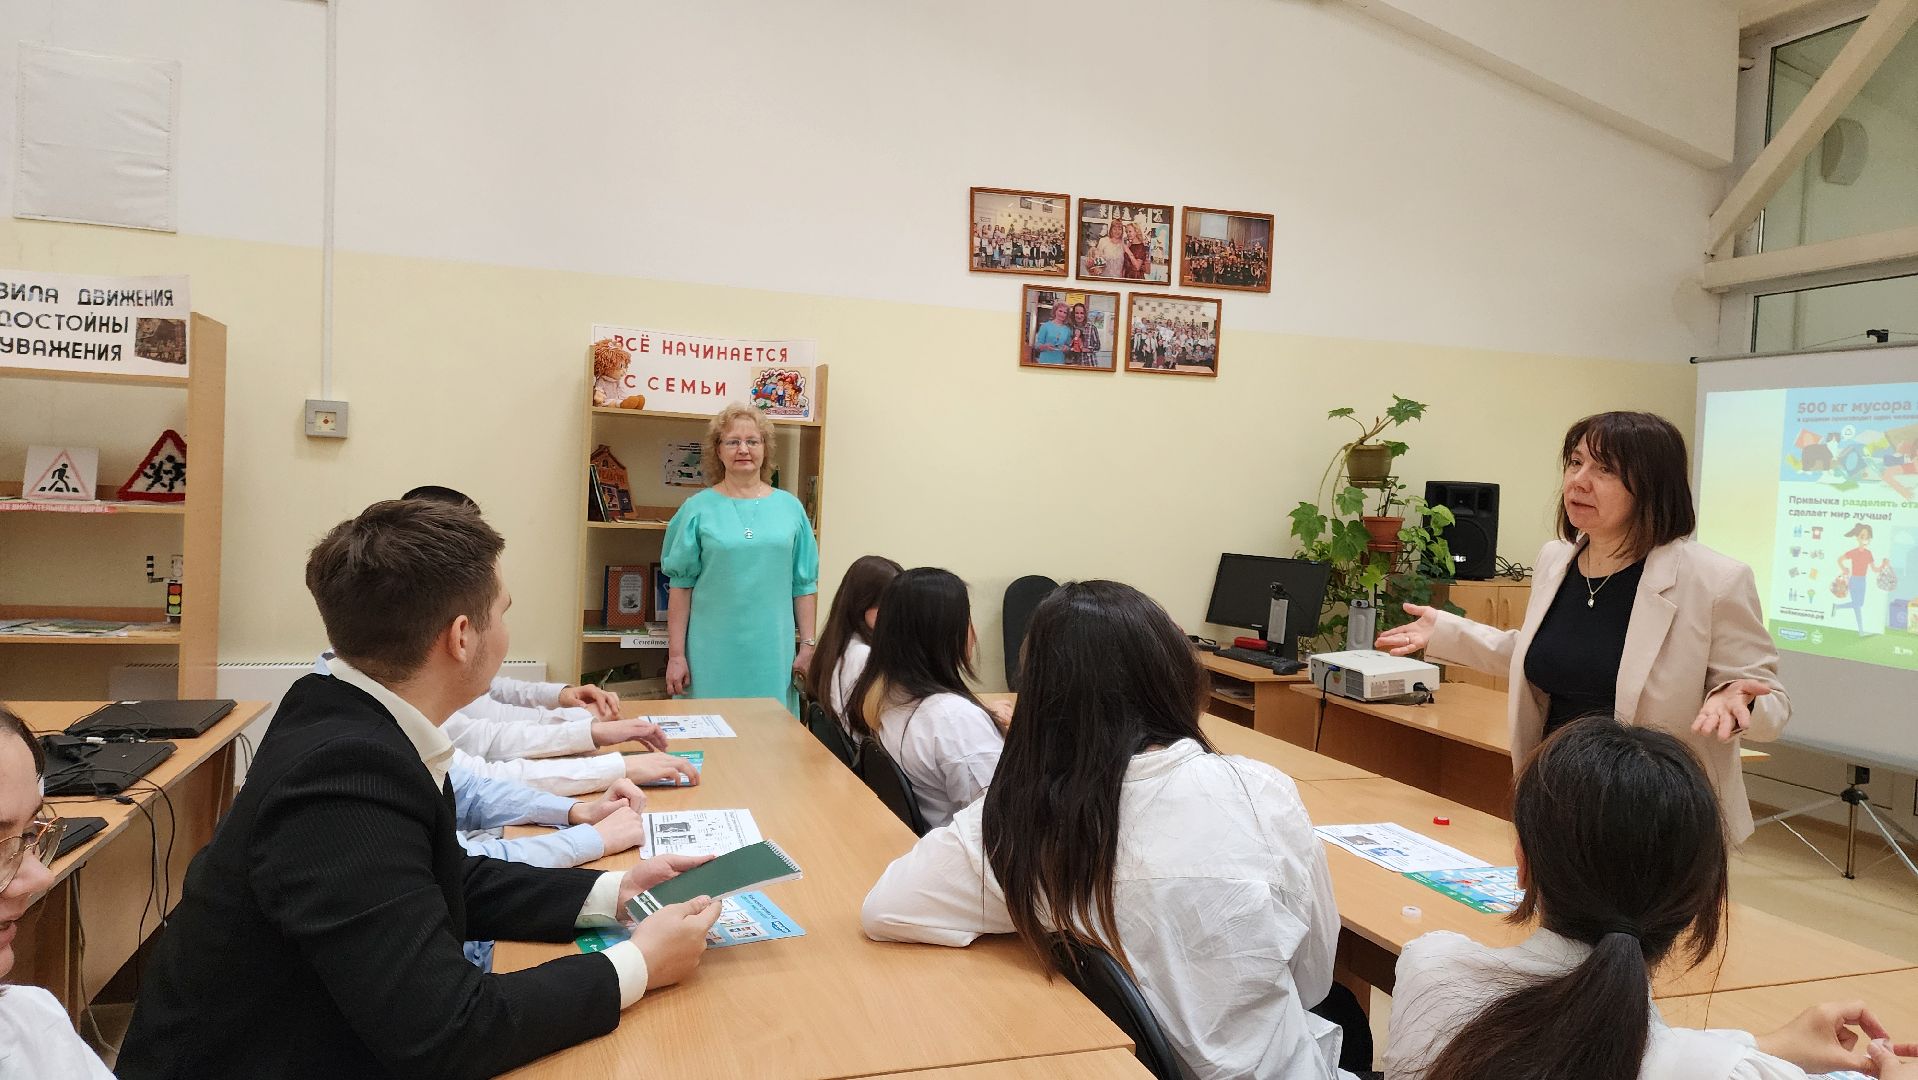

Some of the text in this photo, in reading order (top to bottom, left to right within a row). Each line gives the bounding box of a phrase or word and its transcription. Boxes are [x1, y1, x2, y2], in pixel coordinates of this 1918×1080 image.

[77, 287, 174, 307] ДВИЖЕНИЯ
[0, 310, 129, 334] ДОСТОЙНЫ
[0, 336, 122, 361] УВАЖЕНИЯ
[662, 339, 788, 362] НАЧИНАЕТСЯ
[624, 374, 726, 397] С СЕМЬИ
[1798, 401, 1912, 415] 500 кг мусора
[1788, 495, 1840, 506] Привычка
[1842, 498, 1899, 509] разделять
[1788, 509, 1893, 522] сделает мир лучше!
